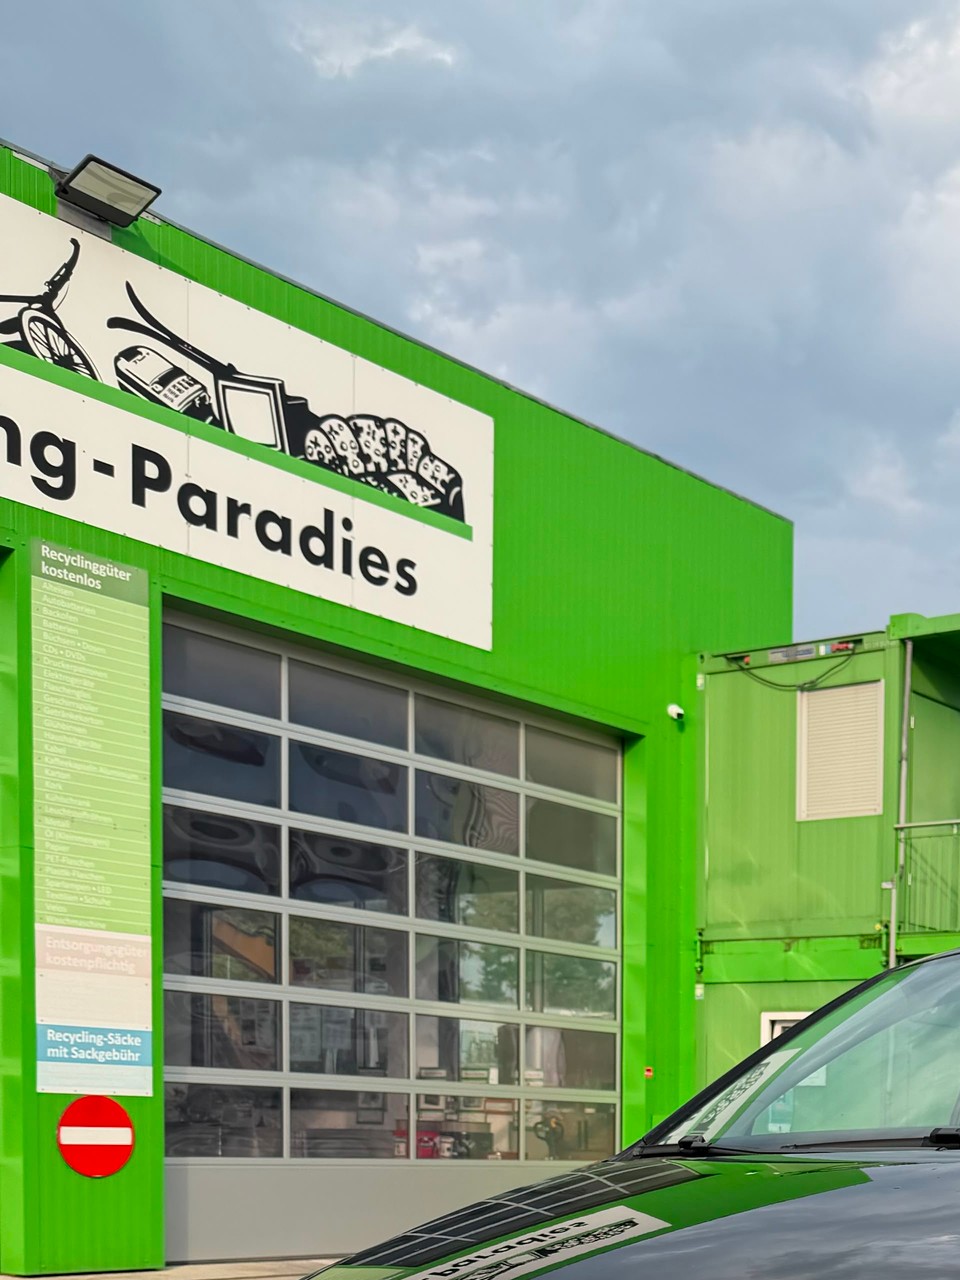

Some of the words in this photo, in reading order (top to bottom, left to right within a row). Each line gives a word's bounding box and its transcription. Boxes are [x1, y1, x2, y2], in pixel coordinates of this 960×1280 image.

[41, 545, 132, 581] Recyclinggüter
[41, 561, 102, 590] kostenlos
[46, 952, 136, 975] kostenpflichtig
[47, 1029, 142, 1047] Recycling-Säcke
[47, 1045, 69, 1058] mit
[71, 1047, 141, 1063] Sackgebühr
